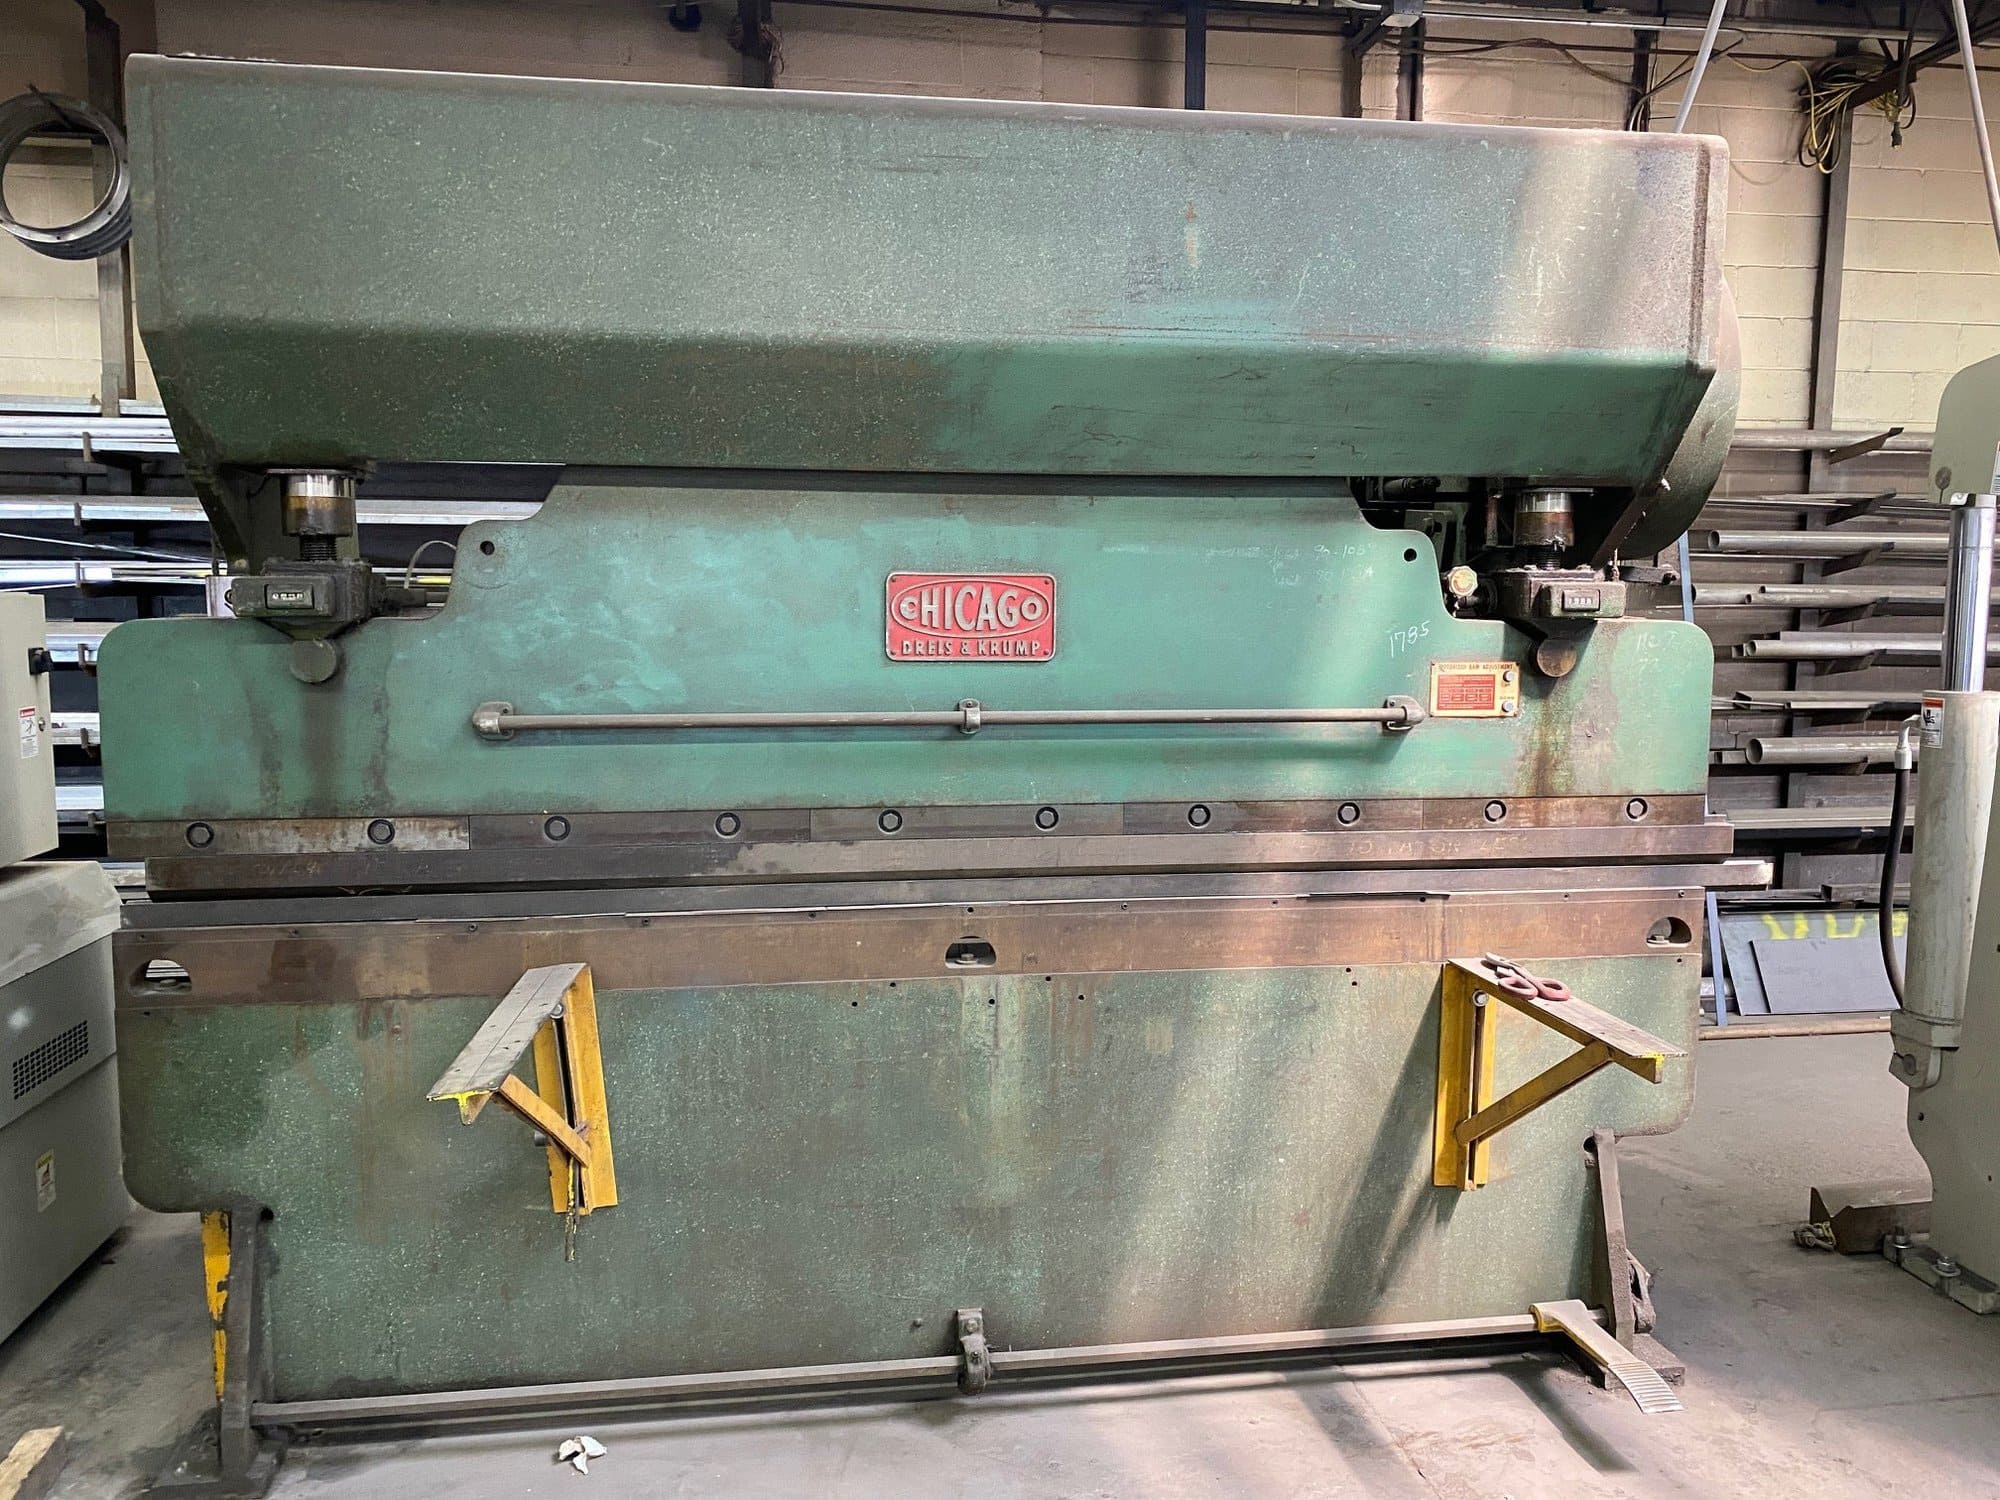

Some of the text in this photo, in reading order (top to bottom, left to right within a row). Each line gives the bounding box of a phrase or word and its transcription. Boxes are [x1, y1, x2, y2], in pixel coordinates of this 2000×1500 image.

[899, 584, 1043, 632] CHICAGO
[901, 640, 1041, 656] DREIS & KRUMP
[1390, 620, 1431, 659] 1785
